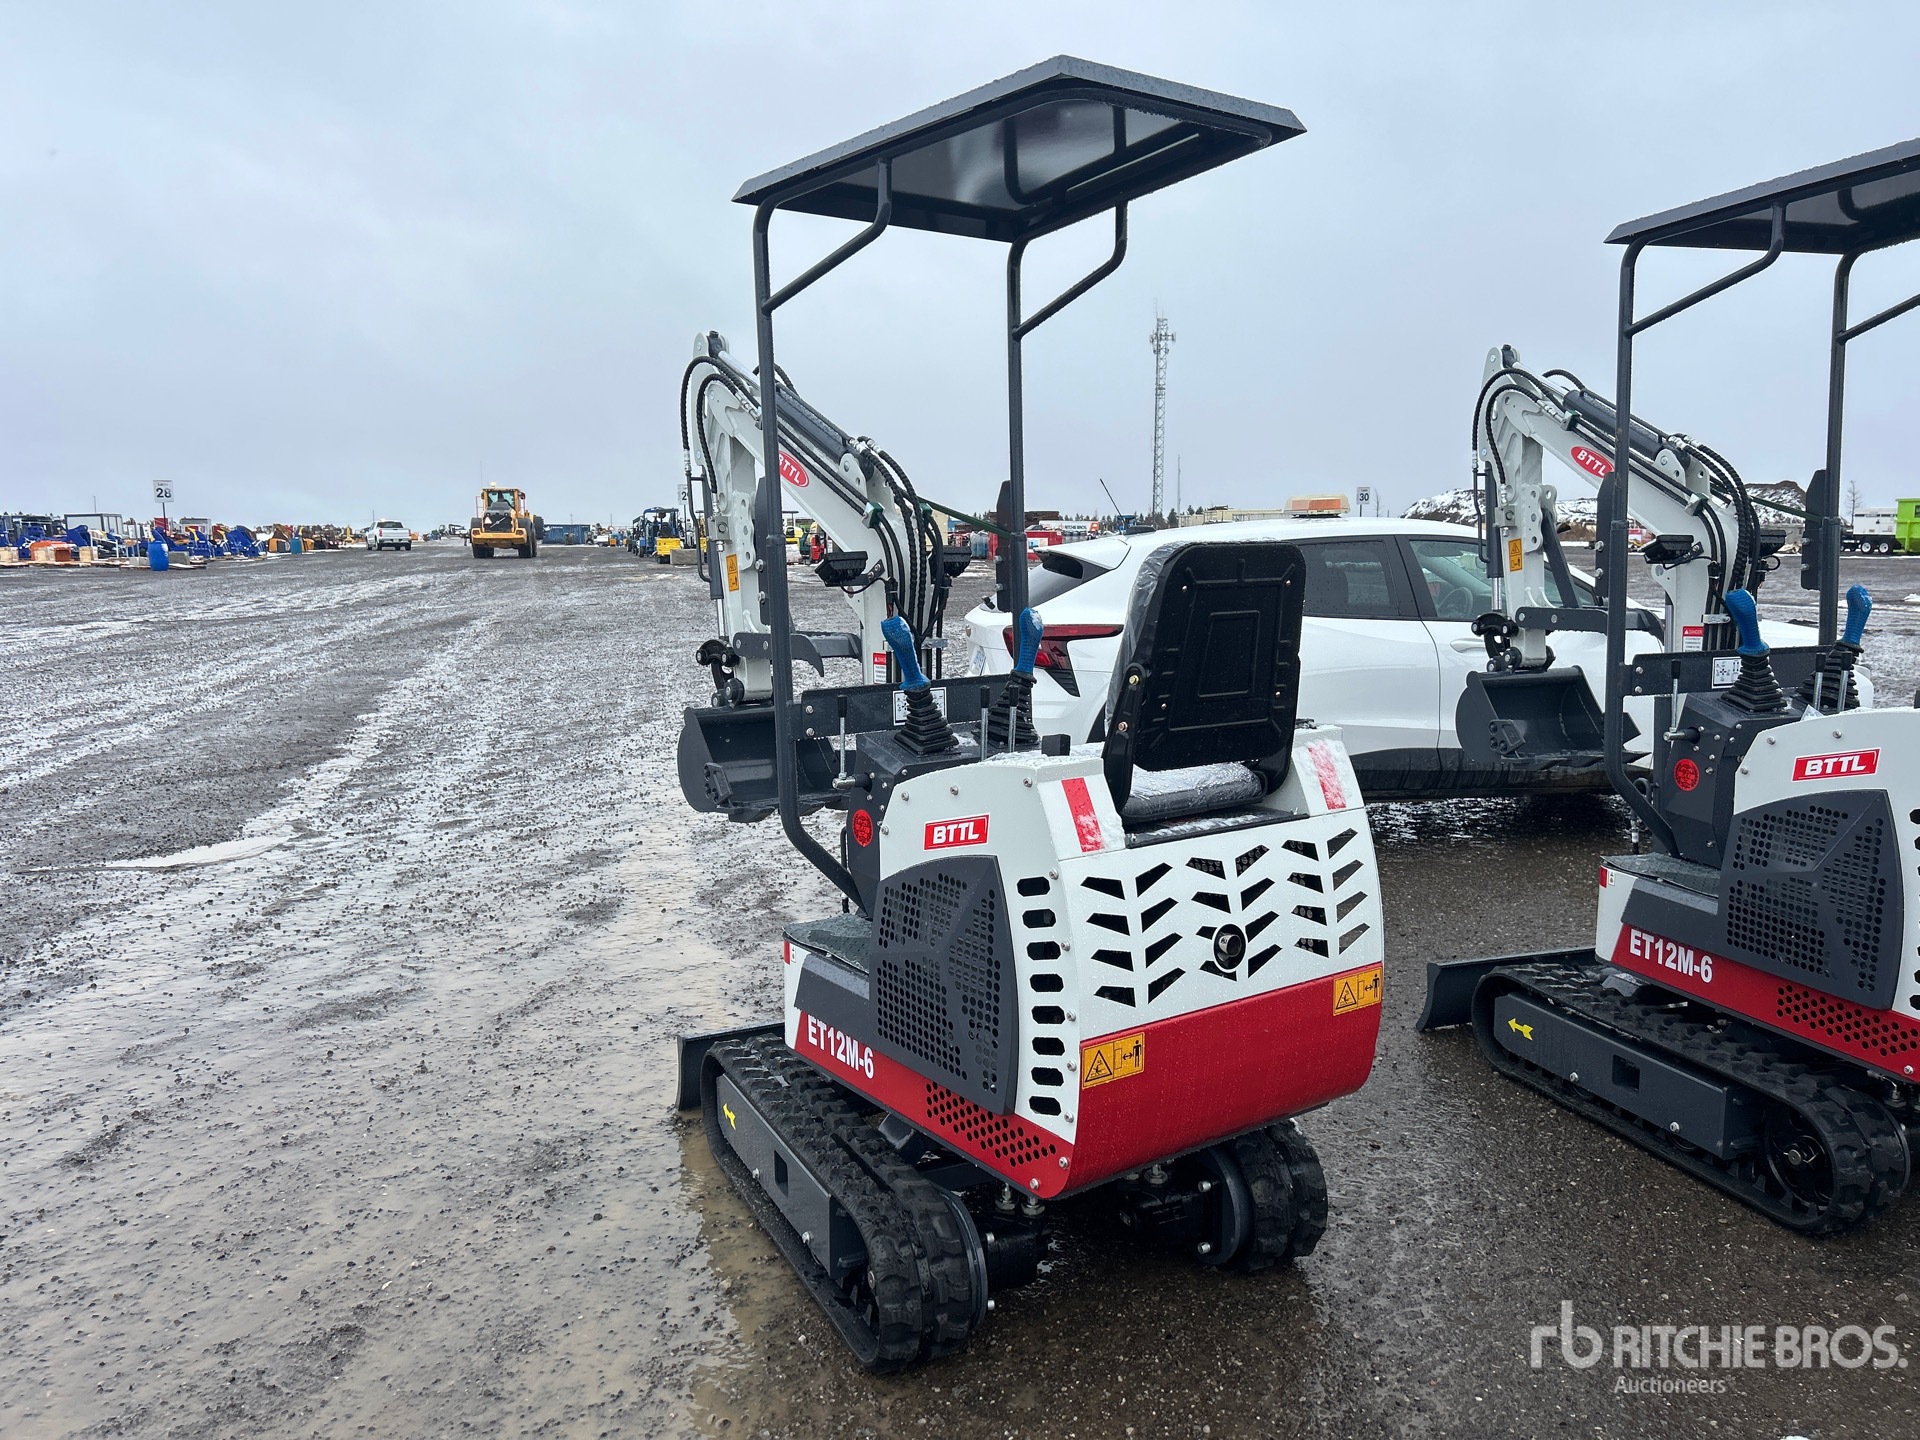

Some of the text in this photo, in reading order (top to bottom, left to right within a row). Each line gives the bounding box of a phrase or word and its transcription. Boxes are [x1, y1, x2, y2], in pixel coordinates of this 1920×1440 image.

[1577, 449, 1606, 476] BTTL
[156, 487, 172, 498] 28
[1359, 492, 1370, 501] 30
[1804, 755, 1867, 777] BTTL
[932, 821, 980, 845] BTTL
[1629, 928, 1713, 984] ET12M-6
[807, 1013, 875, 1080] ET12M-6
